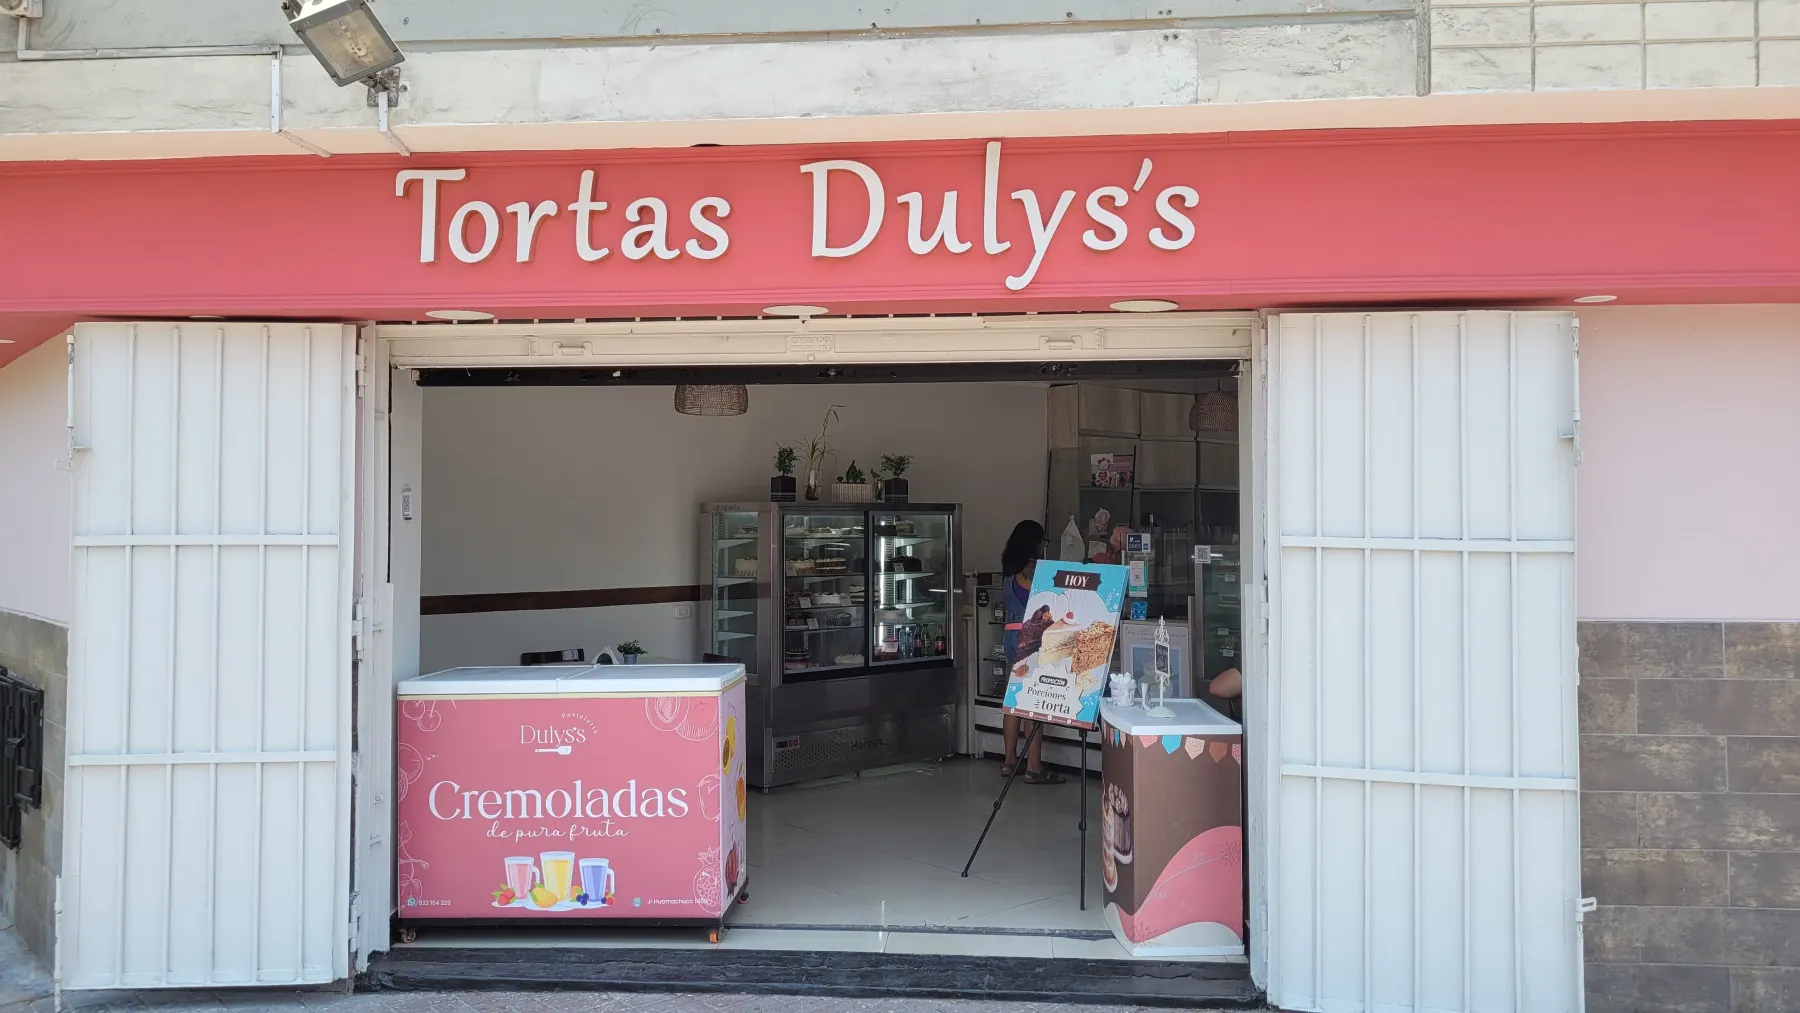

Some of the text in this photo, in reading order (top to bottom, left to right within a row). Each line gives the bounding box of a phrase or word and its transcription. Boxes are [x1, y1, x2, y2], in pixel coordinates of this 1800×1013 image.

[395, 141, 1199, 290] Tortas Dulys's
[1064, 574, 1090, 587] HOY
[1027, 686, 1067, 701] Porciones
[1041, 699, 1071, 715] torta
[428, 779, 689, 820] Cremoladas
[486, 818, 630, 843] de pura fruta
